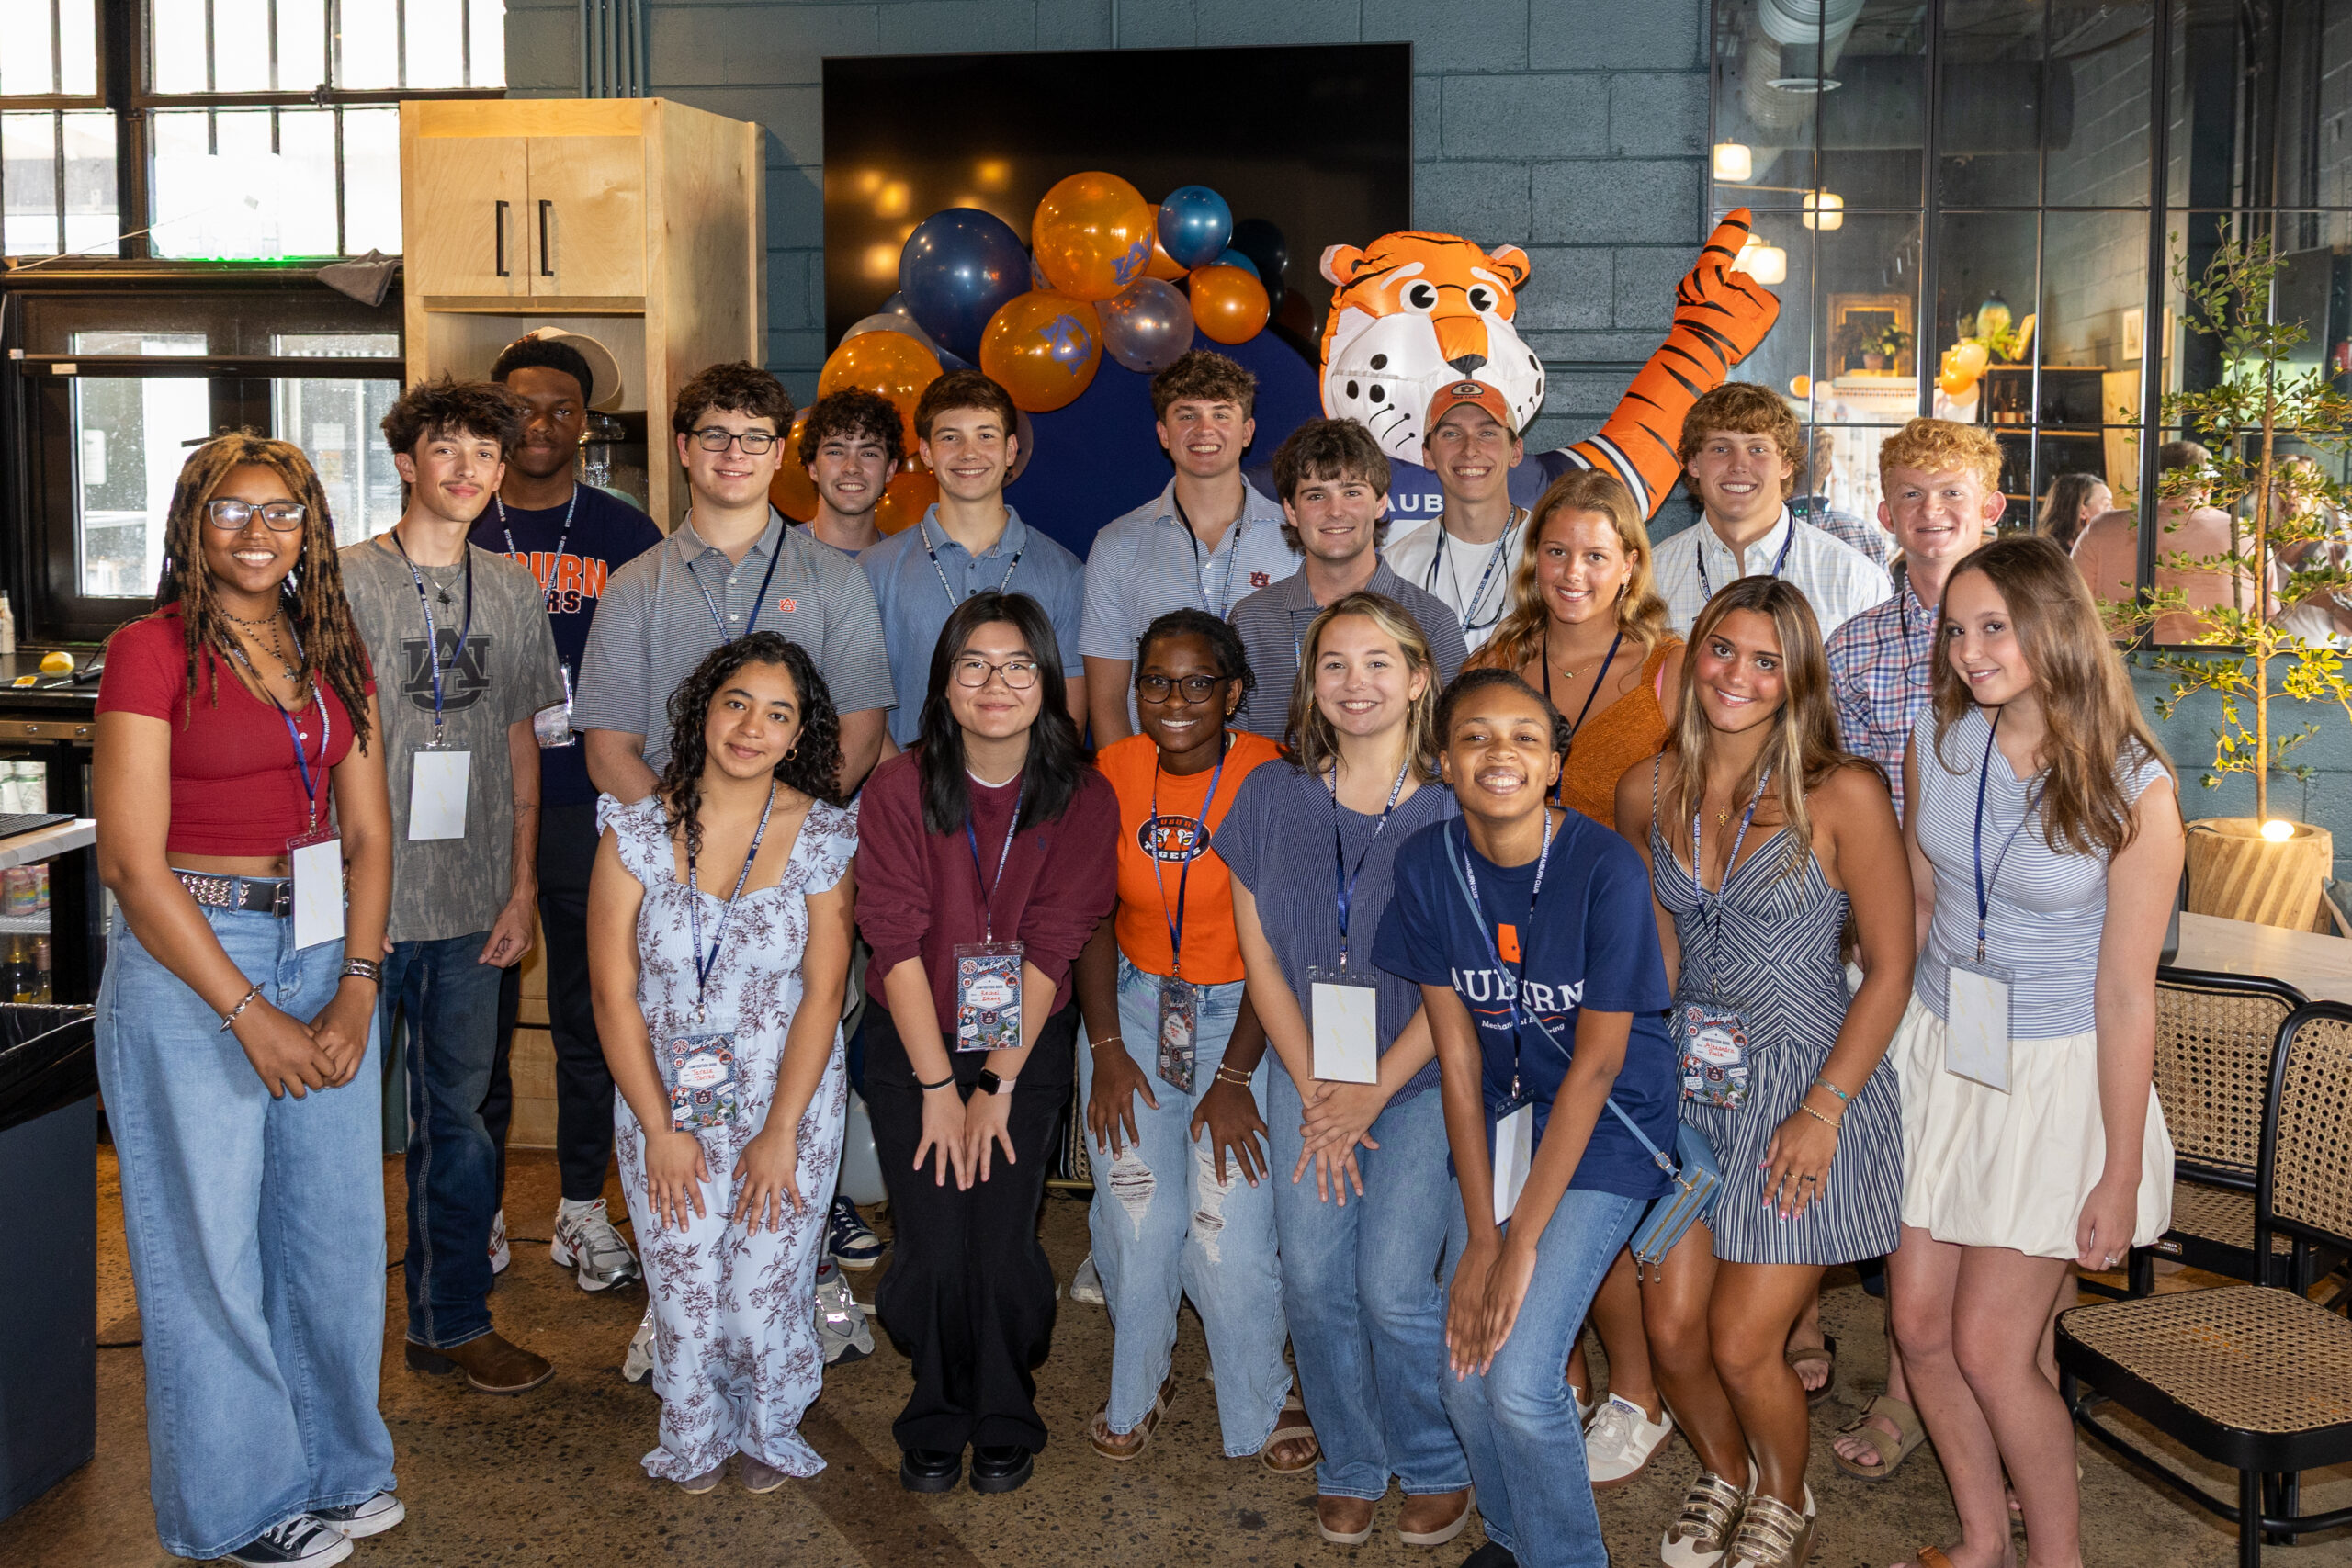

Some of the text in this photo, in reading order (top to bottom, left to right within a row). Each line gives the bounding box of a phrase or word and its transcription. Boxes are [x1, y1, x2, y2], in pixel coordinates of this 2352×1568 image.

[503, 528, 512, 539] CLUB
[1489, 547, 1499, 565] GREATER
[1496, 525, 1510, 548] BIRMINGHAM
[933, 559, 941, 570] CLUB
[1479, 577, 1487, 588] CLUB
[422, 599, 432, 620] GREATER
[427, 619, 436, 647] BIRMINGHAM
[720, 628, 729, 640] CLUB
[1392, 777, 1403, 794] AUBURN
[1386, 793, 1396, 806] CLUB
[754, 822, 766, 844] GREATER
[1007, 813, 1018, 836] GREATER
[1144, 841, 1201, 859] TGERS
[1541, 824, 1551, 858] BIRMINGHAM
[1536, 857, 1546, 880] AUBURN
[1716, 819, 1749, 908] GREATER BIRMINGHAM AUBURN CLUB
[1465, 862, 1479, 899] AUBURN CLUB
[1532, 879, 1542, 894] CLUB
[717, 858, 752, 939] GREATER BIRMINGHAM AUBURN CLUB
[1695, 889, 1703, 905] CLUB
[1705, 1042, 1735, 1053] Alexandra
